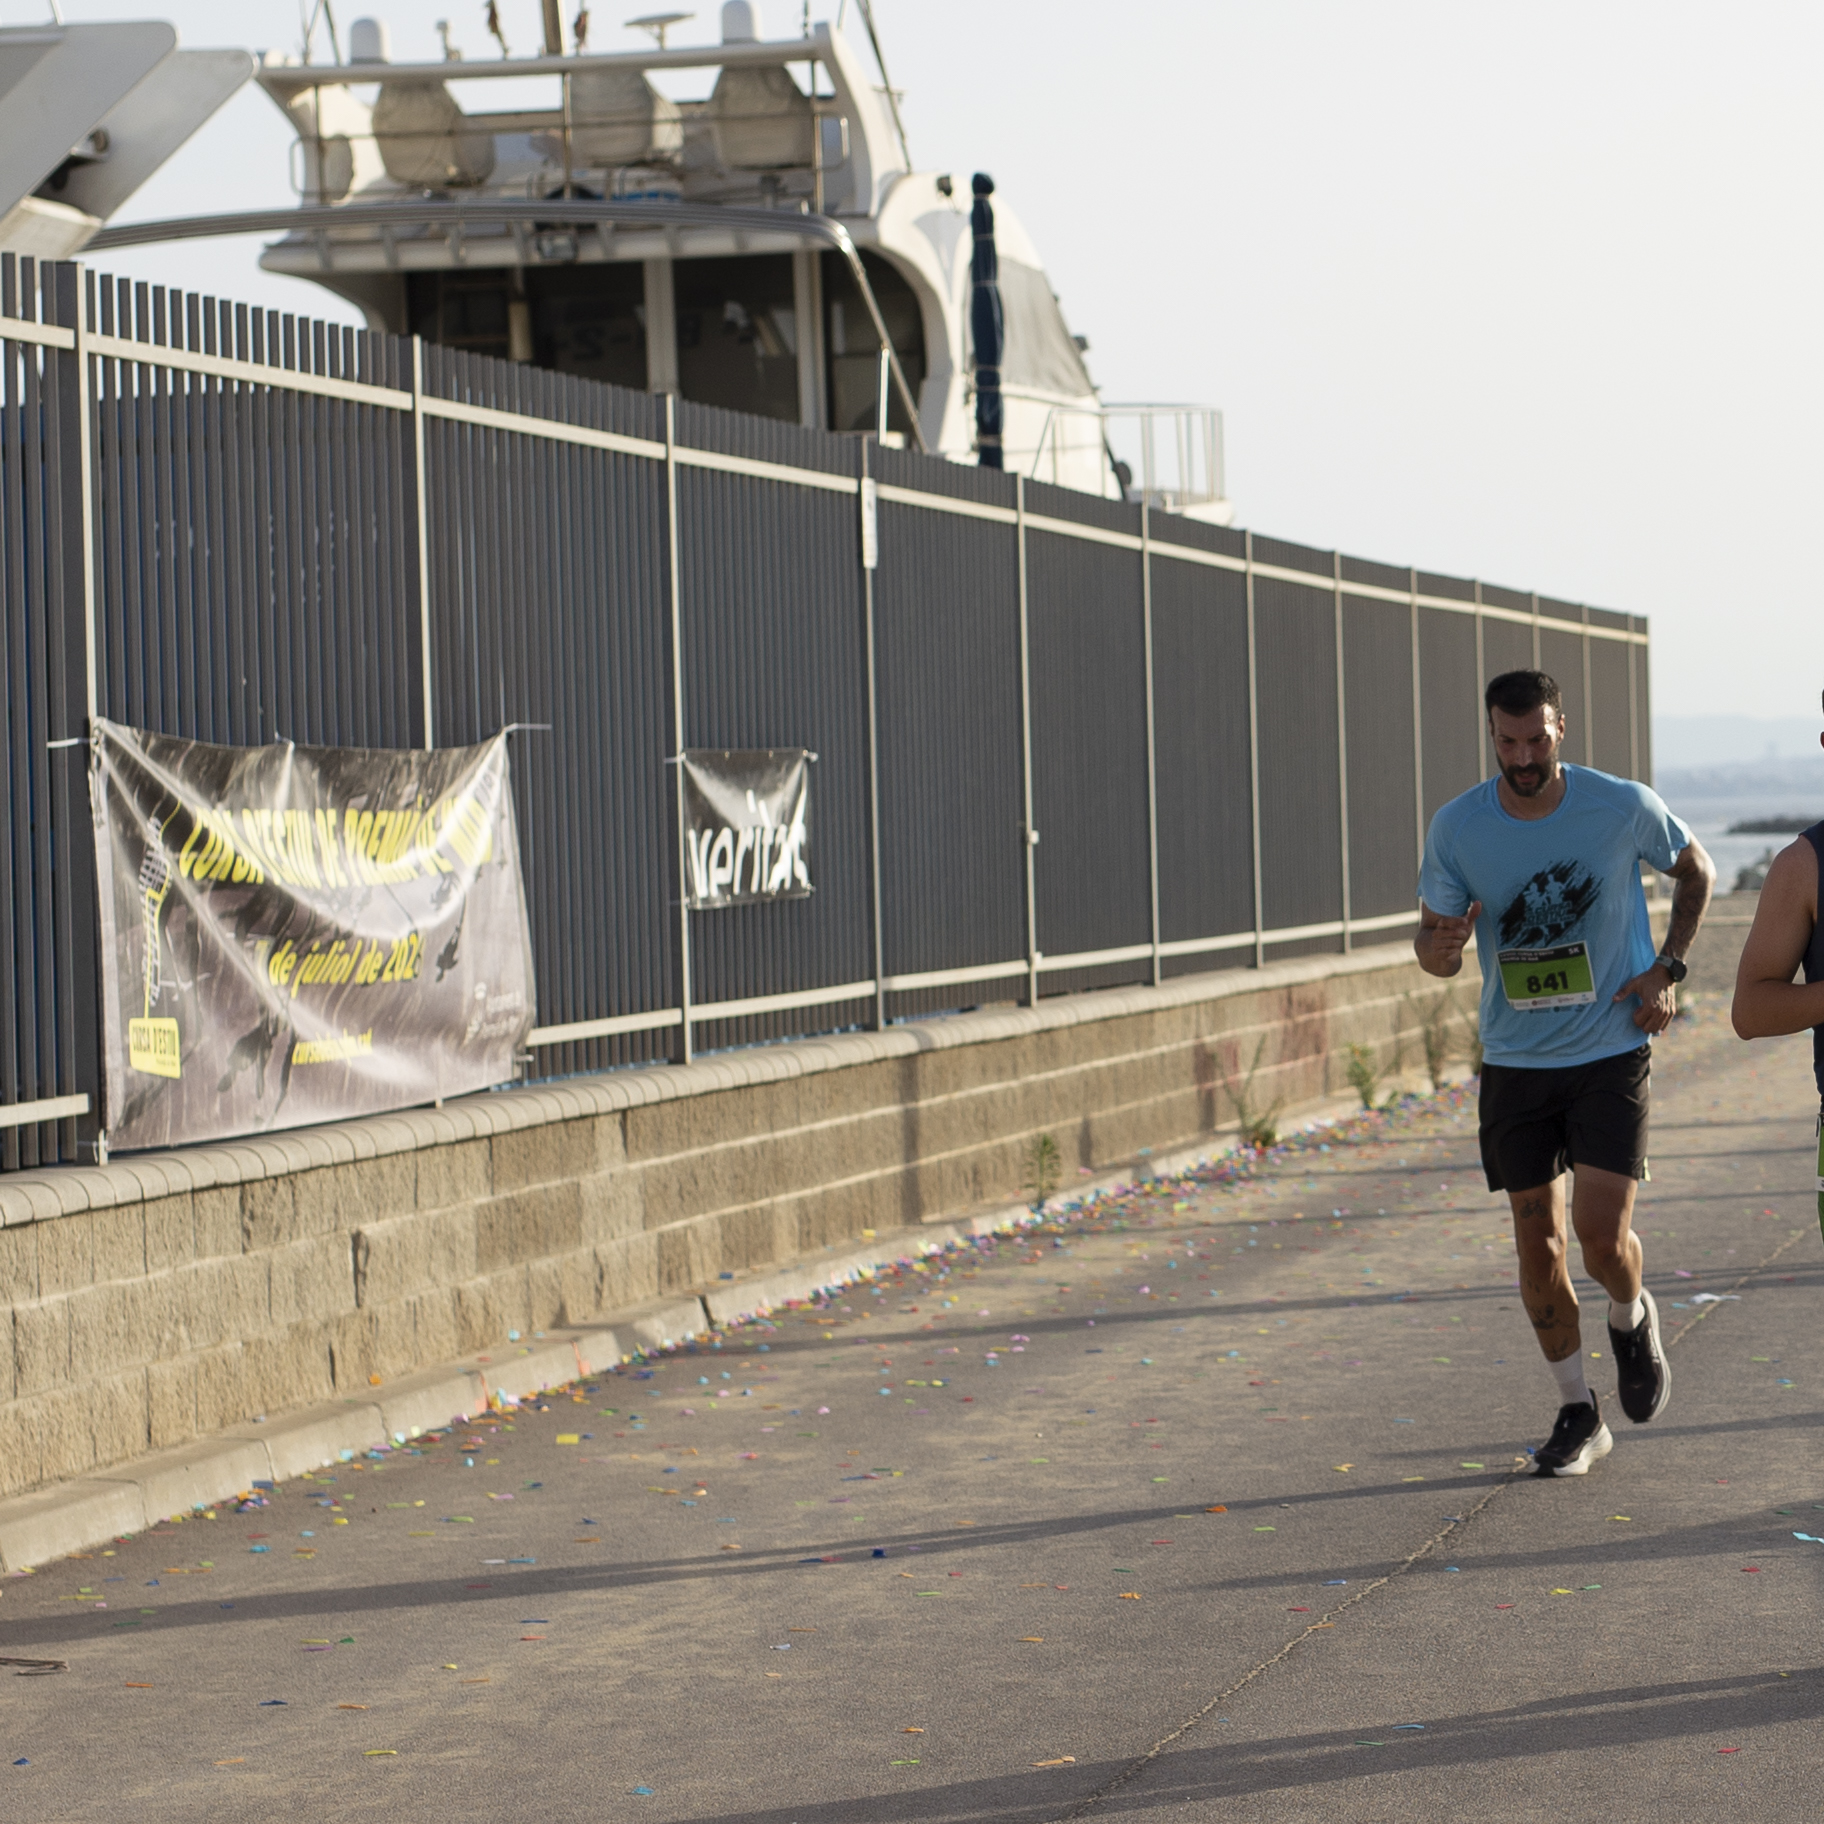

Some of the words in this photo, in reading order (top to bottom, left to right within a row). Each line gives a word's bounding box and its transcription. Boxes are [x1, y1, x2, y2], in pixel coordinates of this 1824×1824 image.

[269, 939, 298, 986] de
[290, 938, 363, 1000] juliol
[355, 938, 384, 985] de
[381, 932, 425, 984] 202
[1526, 971, 1568, 994] 841
